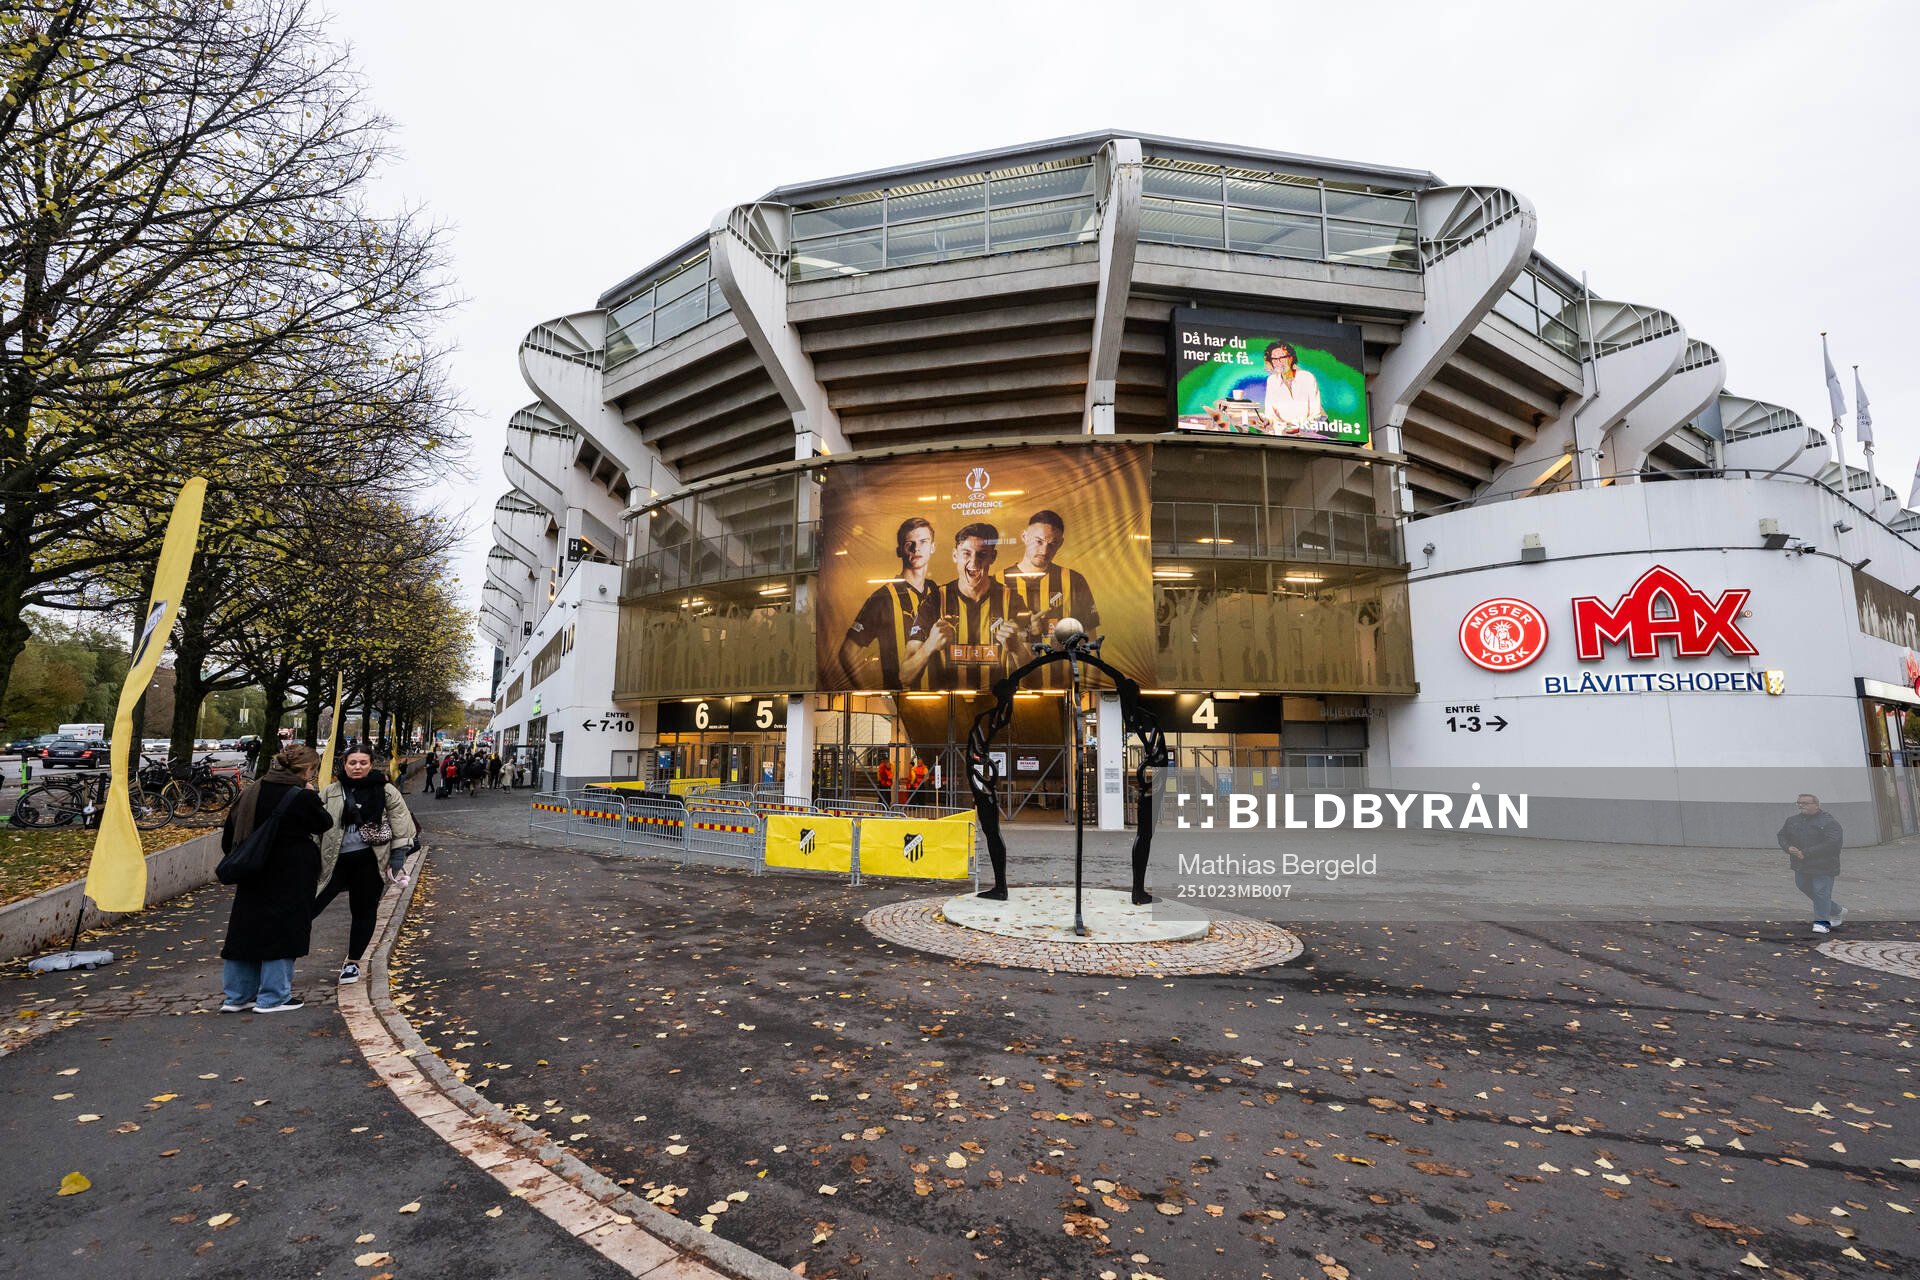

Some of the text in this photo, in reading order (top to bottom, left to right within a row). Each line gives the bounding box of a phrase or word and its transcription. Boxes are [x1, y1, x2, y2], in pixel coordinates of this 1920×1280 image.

[1183, 332, 1247, 349] Då har du
[1183, 349, 1254, 365] mer att få.
[951, 500, 1003, 510] CONFERENCE
[962, 507, 992, 516] LEAGUE
[571, 541, 578, 551] H
[1470, 605, 1533, 629] MISTER
[1572, 564, 1759, 661] MAX
[1481, 647, 1529, 663] YORK
[1545, 671, 1764, 694] BLÅVITTSHOPEN
[695, 703, 709, 729] 6
[755, 701, 773, 728] 5
[1192, 698, 1218, 729] 4
[1445, 704, 1480, 713] ENTRÉ
[600, 720, 634, 732] 7-10
[1446, 716, 1481, 732] 1-3
